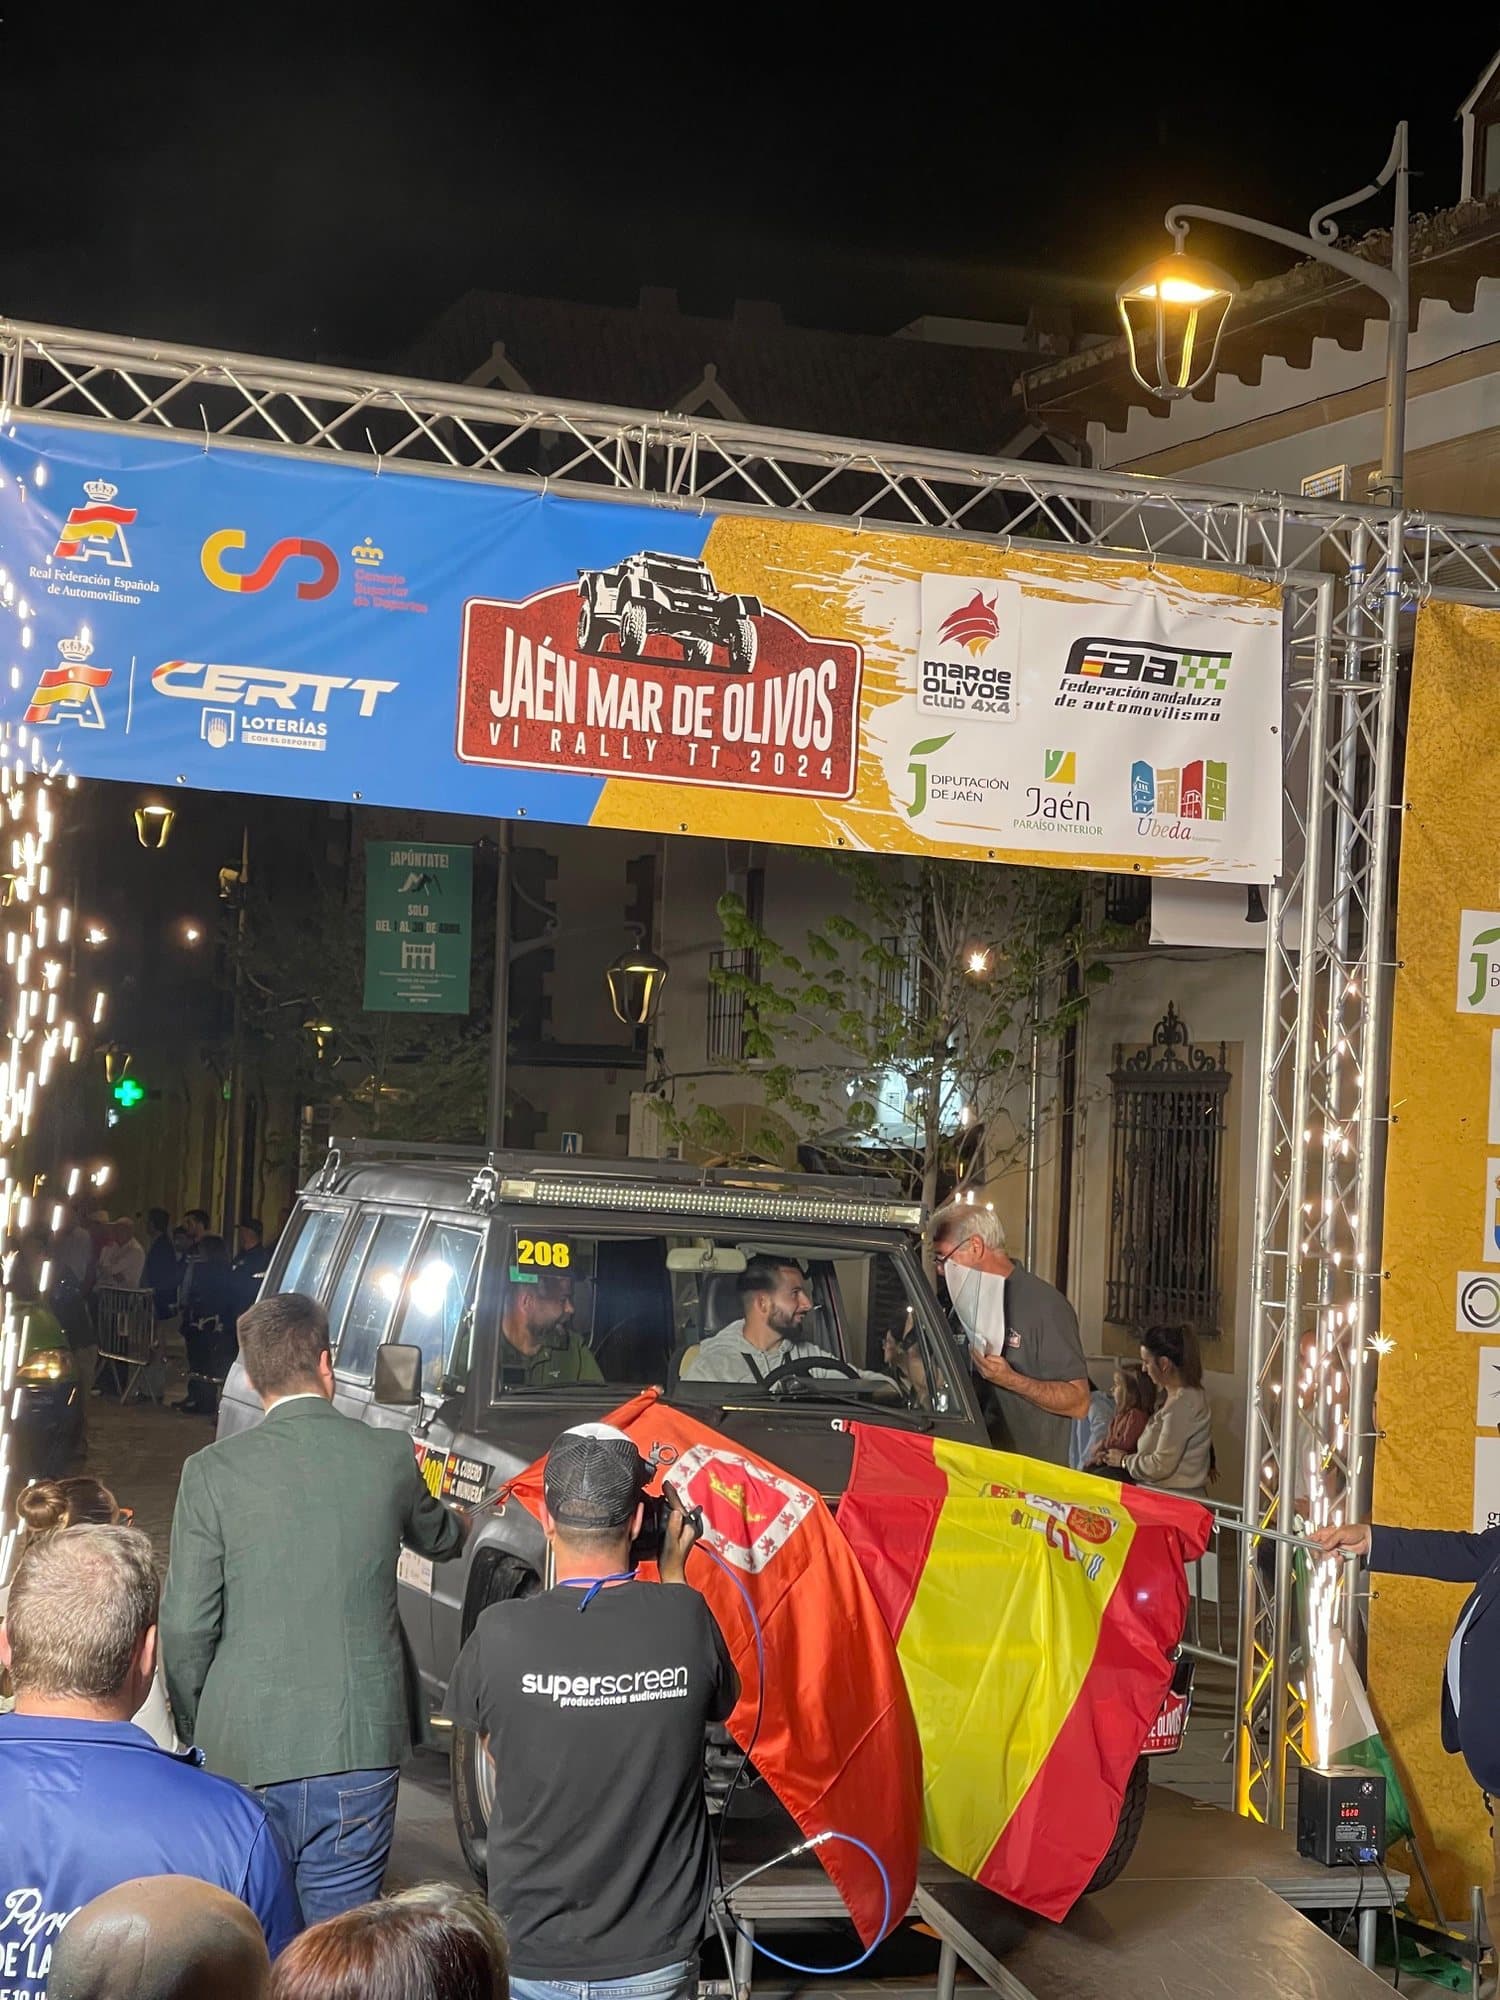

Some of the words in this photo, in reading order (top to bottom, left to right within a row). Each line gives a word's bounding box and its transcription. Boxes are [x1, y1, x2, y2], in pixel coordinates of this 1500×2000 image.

[29, 566, 52, 579] Real
[54, 569, 111, 586] Federación
[114, 576, 160, 593] Española
[47, 583, 61, 595] de
[62, 585, 141, 605] Automovilismo
[151, 659, 401, 718] CERTT
[488, 626, 578, 724] JAÉN
[586, 667, 664, 734] MAR
[671, 683, 717, 739] DE
[722, 658, 839, 752] OLIVOS
[1059, 677, 1150, 701] Federación
[1151, 690, 1223, 708] andaluza
[922, 694, 966, 710] club
[970, 698, 1011, 714] 4x4
[1054, 693, 1078, 709] de
[1082, 697, 1222, 722] automovilismo
[241, 715, 328, 736] LOTERÍAS
[251, 734, 268, 742] CON
[270, 736, 280, 744] EL
[281, 737, 318, 748] DEPORTE
[487, 722, 521, 748] VI
[550, 727, 660, 762] RALLY
[688, 742, 723, 770] TT
[750, 749, 834, 781] 2024
[931, 773, 1010, 791] DIPUTACIÓN
[931, 788, 950, 800] DE
[951, 789, 984, 803] JAÉN
[1025, 786, 1091, 822] Jaén
[1012, 818, 1056, 832] PARAÍSO
[1056, 823, 1104, 837] INTERIOR
[1136, 810, 1192, 841] Úbeda
[390, 848, 449, 869] ¡APÚNTATE!
[407, 903, 429, 917] SOLO
[375, 919, 391, 932] DEL
[399, 920, 411, 934] AL
[425, 921, 437, 934] DE
[517, 1239, 571, 1268] 208
[521, 1665, 689, 1702] superscreen
[559, 1694, 628, 1708] producciones
[629, 1686, 689, 1704] audiovisuales
